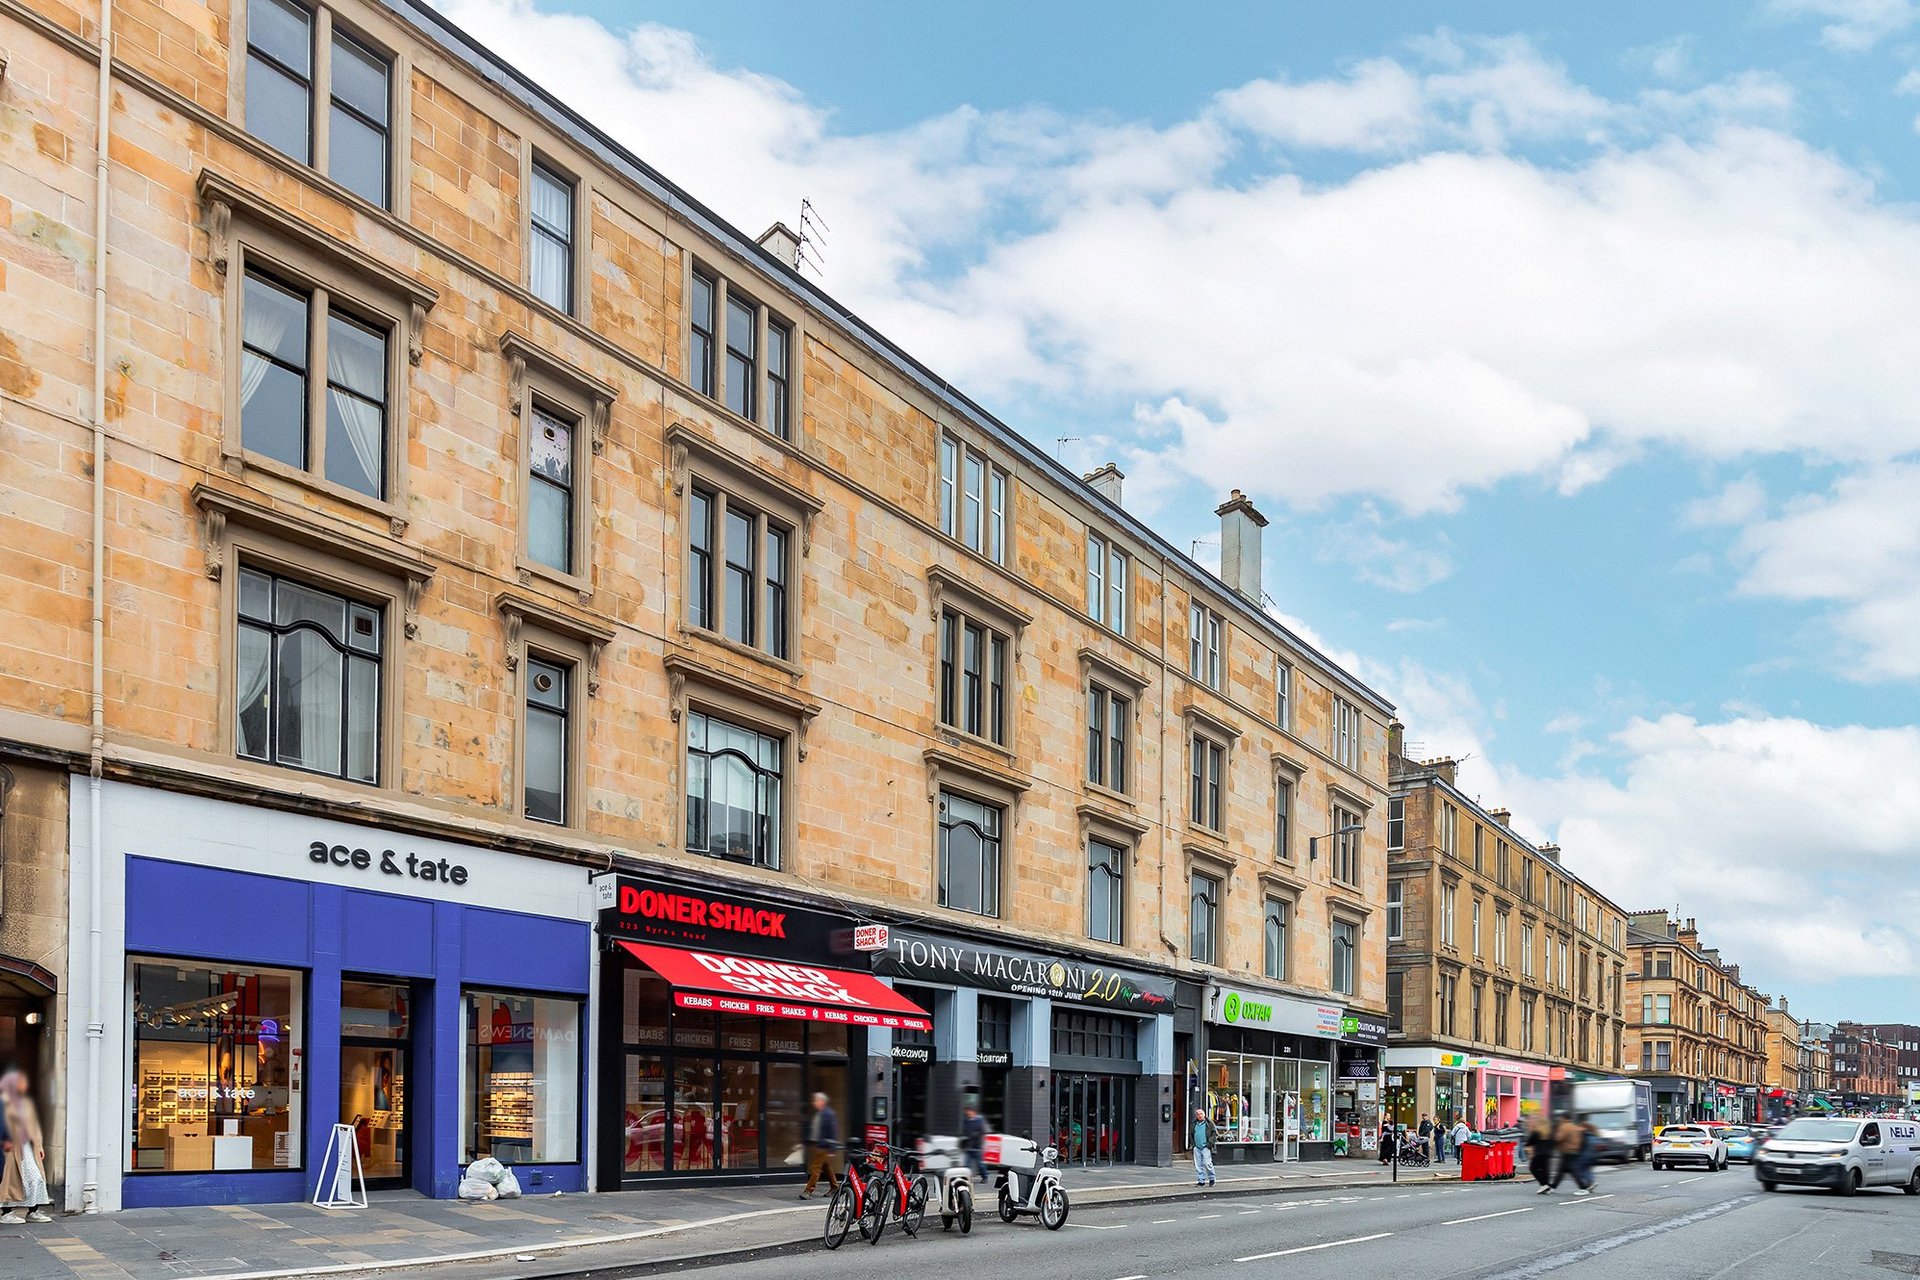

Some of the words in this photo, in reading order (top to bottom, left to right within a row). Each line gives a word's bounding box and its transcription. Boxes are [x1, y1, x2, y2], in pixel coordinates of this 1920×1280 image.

[309, 841, 371, 870] ace
[380, 849, 403, 875] &
[406, 852, 469, 885] tate
[620, 886, 707, 927] DONER
[708, 902, 786, 939] SHACK
[620, 921, 638, 930] 223
[856, 927, 877, 938] DONER
[856, 937, 877, 947] SHACK
[690, 952, 842, 987] DONER
[893, 938, 963, 972] TONY
[974, 952, 1086, 991] MACARONI
[1083, 968, 1121, 1002] 2.0
[721, 975, 871, 1005] SHACK
[1011, 984, 1046, 996] OPENING
[1048, 989, 1063, 998] 12th
[1064, 991, 1083, 1001] JUNE
[684, 996, 712, 1007] KEBABS
[720, 1000, 750, 1011] CHICKEN
[756, 1004, 775, 1014] FRIES
[781, 1006, 806, 1017] SHAKES
[825, 1011, 848, 1021] KEBABS
[853, 1014, 879, 1024] CHICKEN
[883, 1017, 899, 1026] FRIES
[903, 1019, 924, 1029] SHAKES
[1357, 1021, 1376, 1033] OLUTION
[638, 1029, 664, 1040] BABS
[675, 1033, 713, 1045] CHICKEN
[729, 1037, 751, 1048] FRIES
[769, 1039, 800, 1050] SHAKES
[891, 1046, 928, 1063] akeaway
[976, 1053, 1008, 1064] staurant
[224, 1086, 255, 1099] tate
